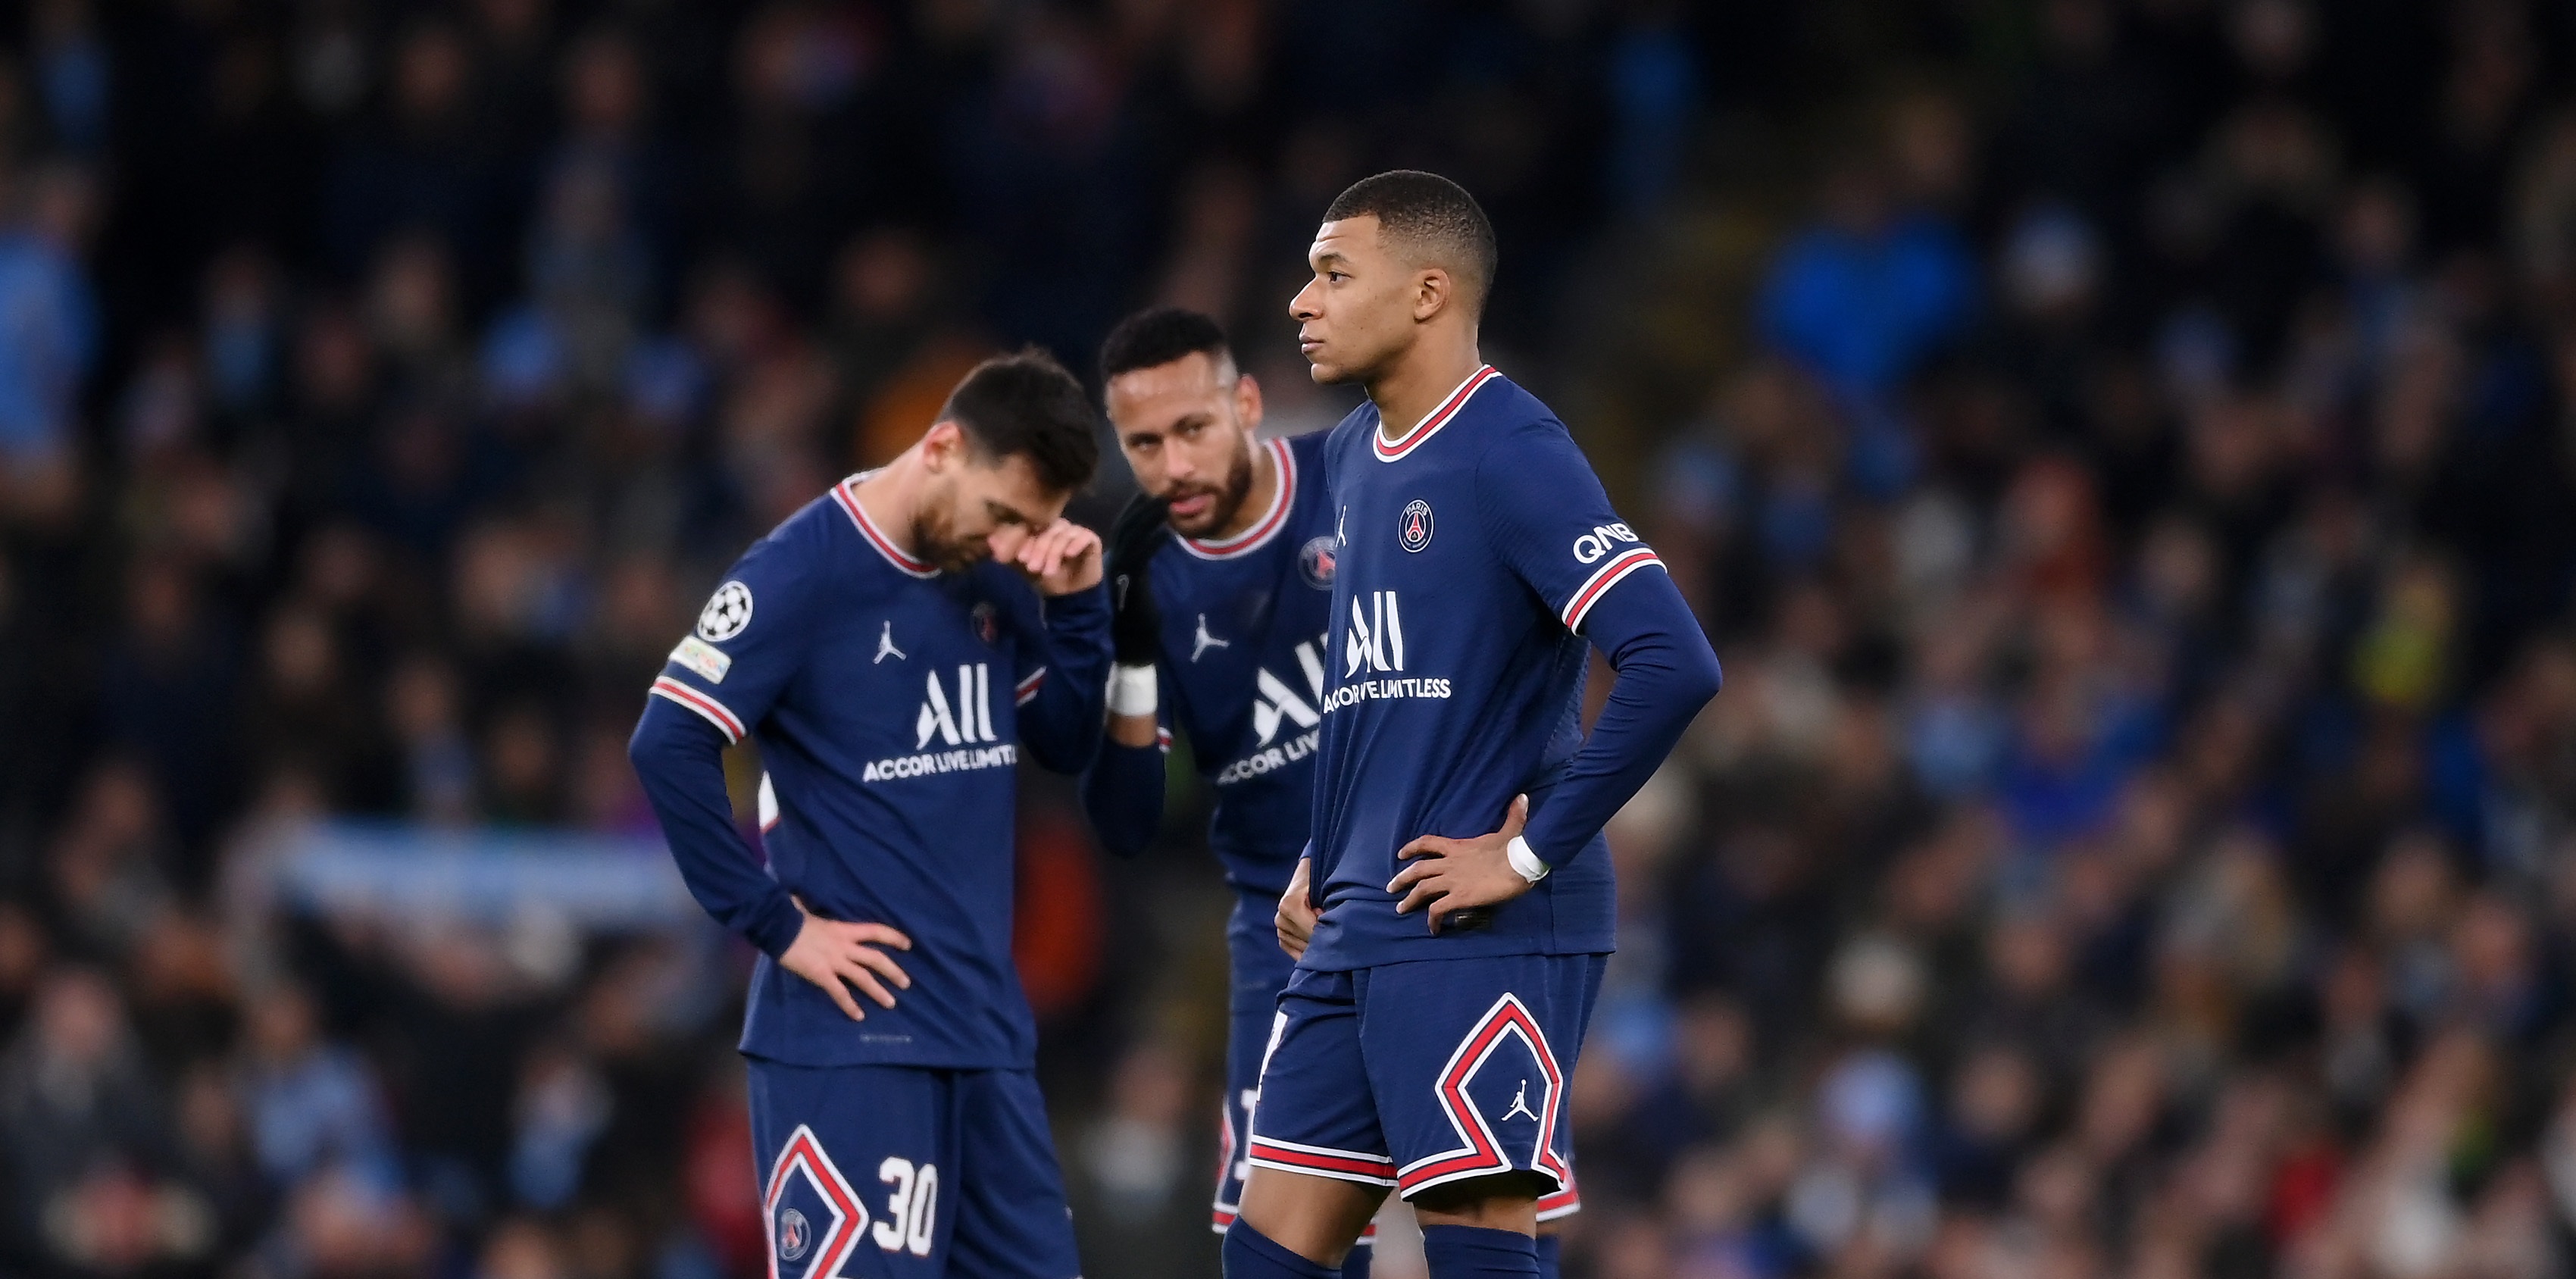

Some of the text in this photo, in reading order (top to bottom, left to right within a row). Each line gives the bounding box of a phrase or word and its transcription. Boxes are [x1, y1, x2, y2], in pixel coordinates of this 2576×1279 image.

[1405, 502, 1428, 516] PARIS
[1573, 523, 1639, 564] QNB
[1283, 728, 1318, 761] LIV
[862, 753, 936, 783] ACCOR
[934, 749, 970, 773] LIVE
[872, 1156, 938, 1257] 30
